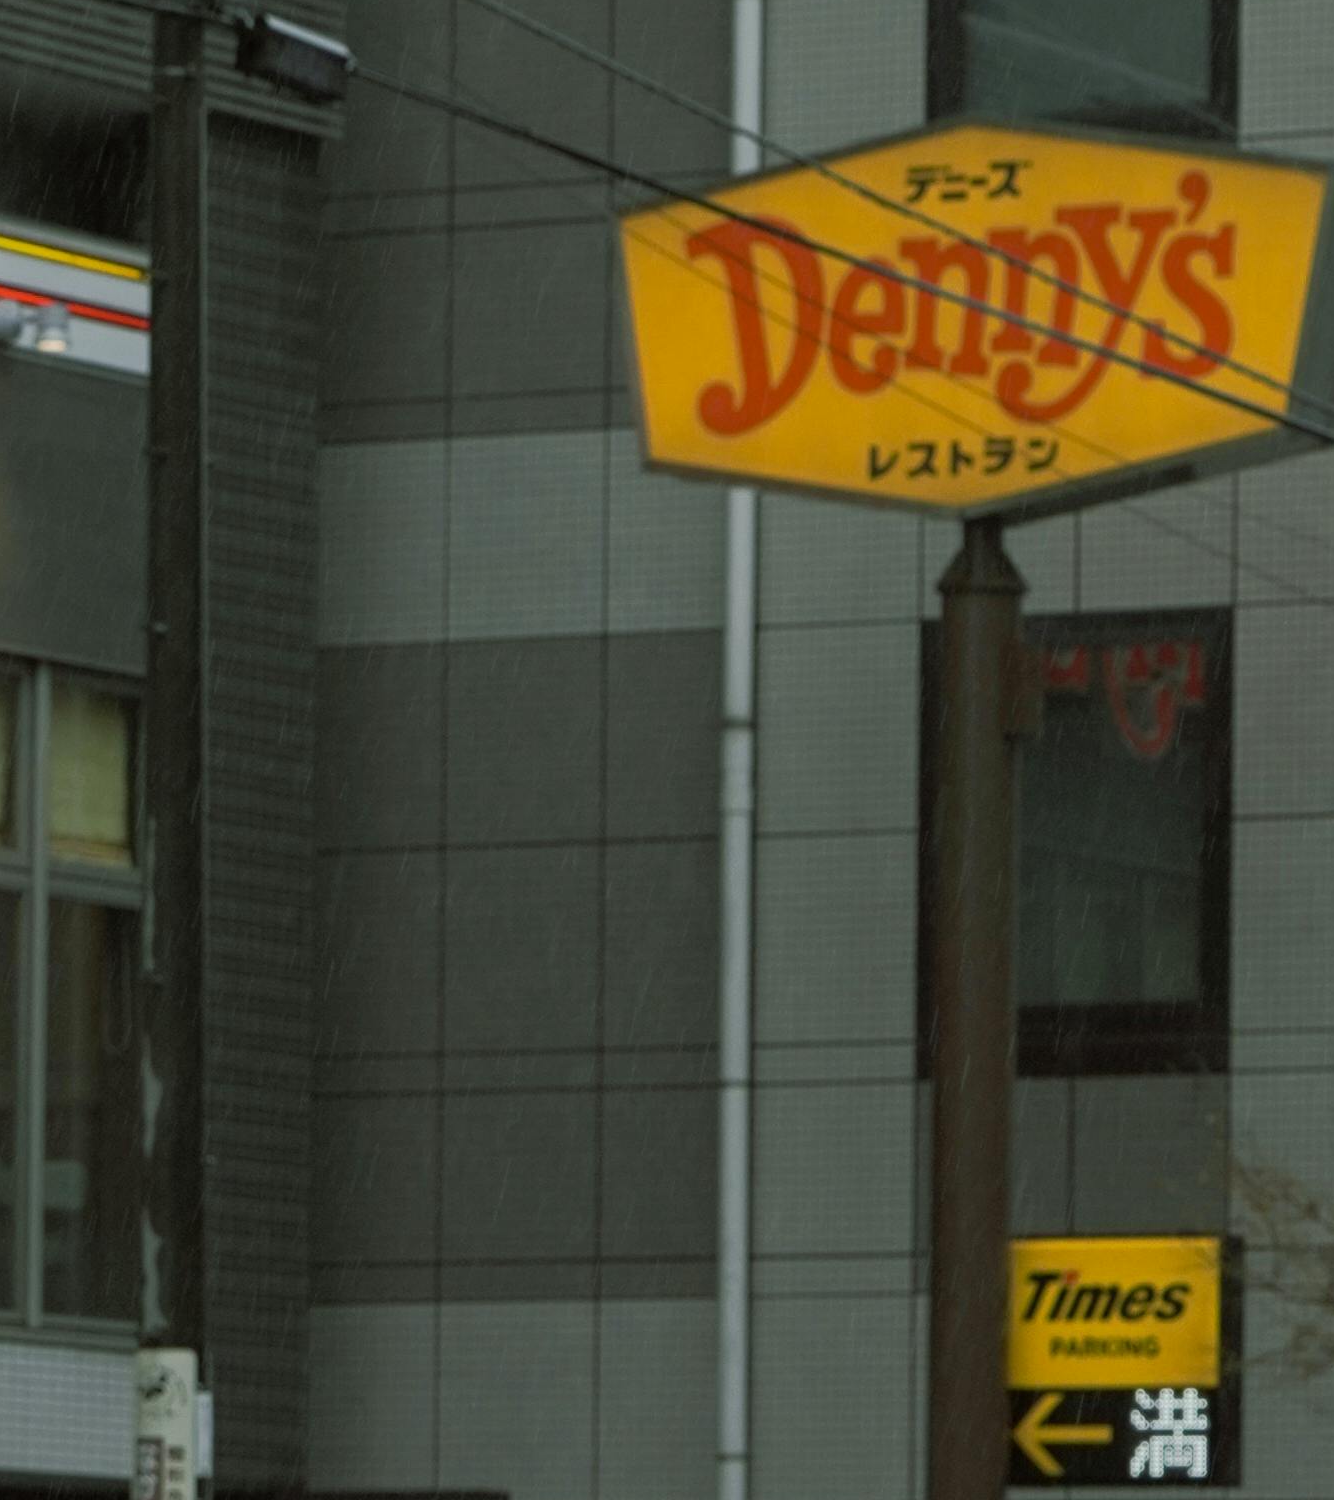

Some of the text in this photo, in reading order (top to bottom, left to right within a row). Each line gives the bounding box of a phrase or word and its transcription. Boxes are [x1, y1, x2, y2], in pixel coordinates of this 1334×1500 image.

[905, 160, 1031, 203] デニーズ
[685, 169, 1236, 438] Denny's
[867, 436, 1060, 481] レストラン
[1021, 1269, 1191, 1323] Times
[1049, 1335, 1160, 1359] PARKING
[1129, 1387, 1208, 1478] 満
